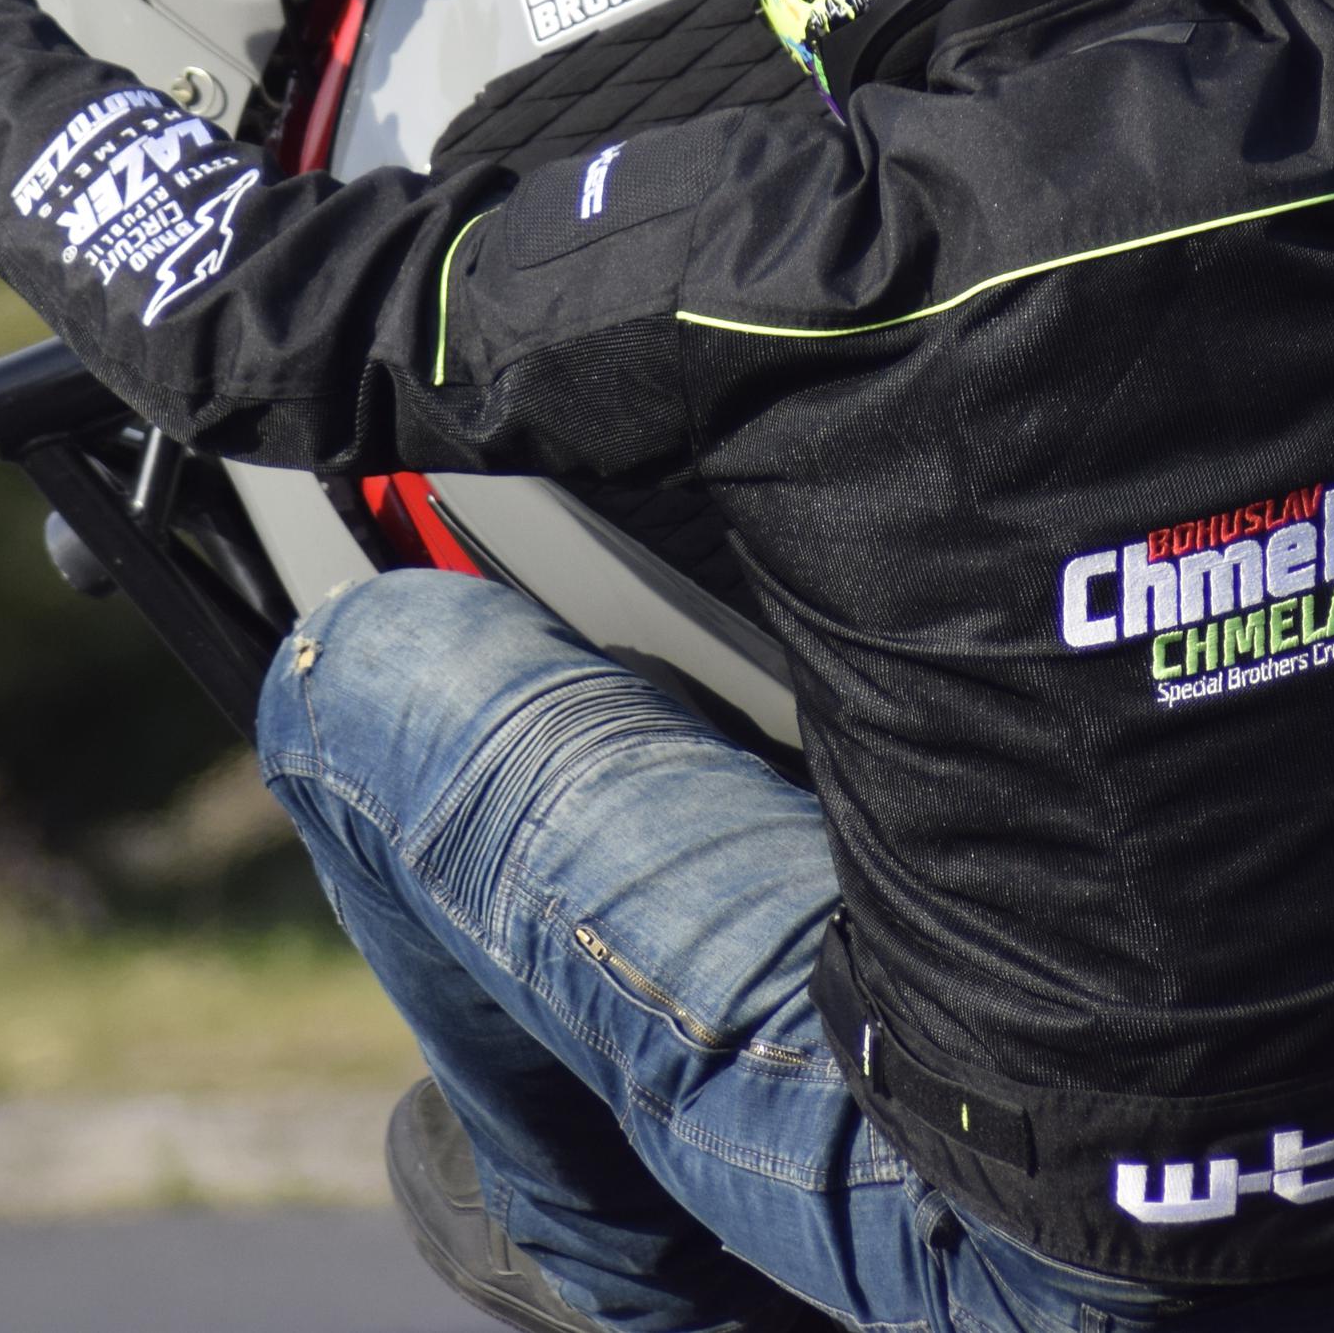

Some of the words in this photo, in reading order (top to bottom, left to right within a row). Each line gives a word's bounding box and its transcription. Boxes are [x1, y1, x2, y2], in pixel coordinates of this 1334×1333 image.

[11, 89, 163, 217] MOTOZEM
[56, 117, 214, 246] LAZER
[98, 200, 185, 286] CIRCUIT
[128, 220, 195, 272] BRNO
[1147, 482, 1324, 564] BOHUSLAV
[1156, 670, 1223, 707] Special
[1227, 651, 1309, 690] Brothers
